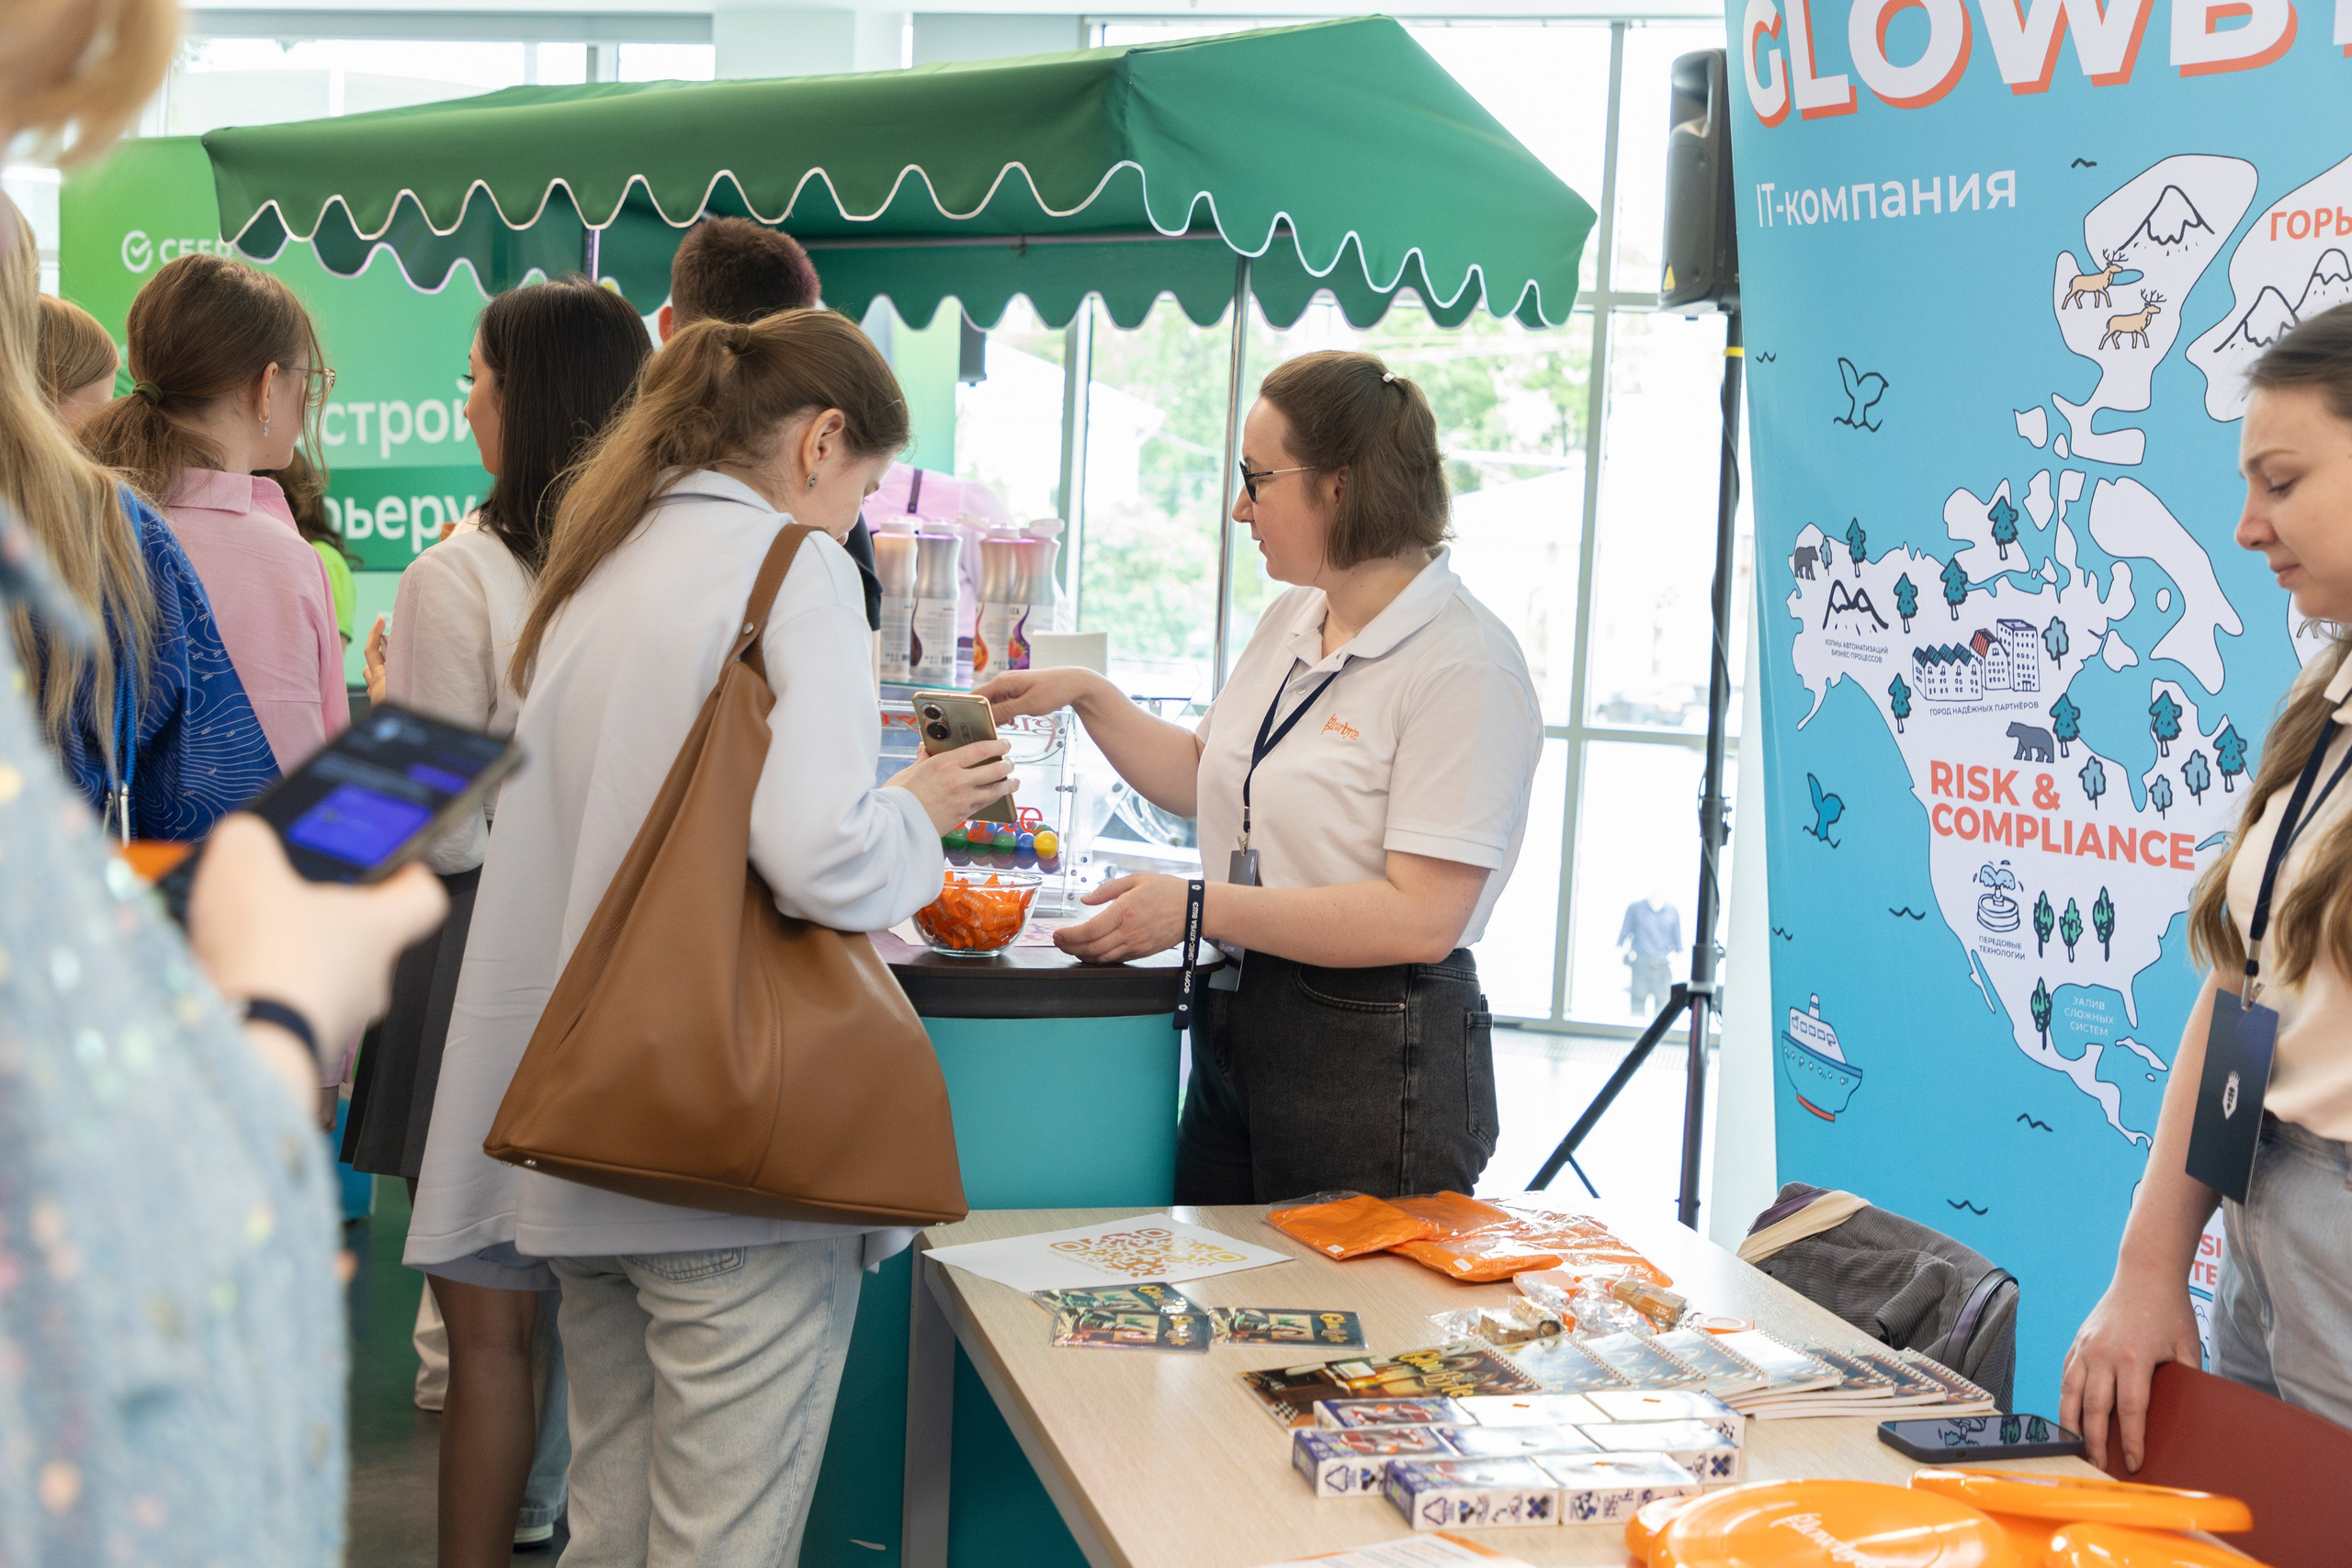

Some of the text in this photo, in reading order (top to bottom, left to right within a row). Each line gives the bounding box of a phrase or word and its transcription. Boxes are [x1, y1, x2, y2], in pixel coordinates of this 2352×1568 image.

[1743, 0, 2352, 128] GLOWB
[1756, 169, 2016, 228] IT-компания
[1831, 649, 1883, 663] БИЗНЕС-ПРОЦЕССОВ
[1842, 641, 1889, 655] АВТОМАТИЗАЦИЙ
[1929, 701, 2039, 716] ГОРОД НАДЁЖНЫХ ПАРТНЁРОВ
[1930, 760, 2062, 811] RISK &
[1931, 802, 2196, 872] COMPLIANCE
[1191, 901, 1200, 919] ВШЭ
[1979, 935, 2022, 950] ПЕРЕДОВЫЕ
[1979, 945, 2026, 961] ТЕХНОЛОГИИ
[2073, 997, 2105, 1010] ЗАЛИВ
[2064, 1007, 2114, 1025] СЛОЖНЫХ
[2069, 1021, 2109, 1036] СИСТЕМ
